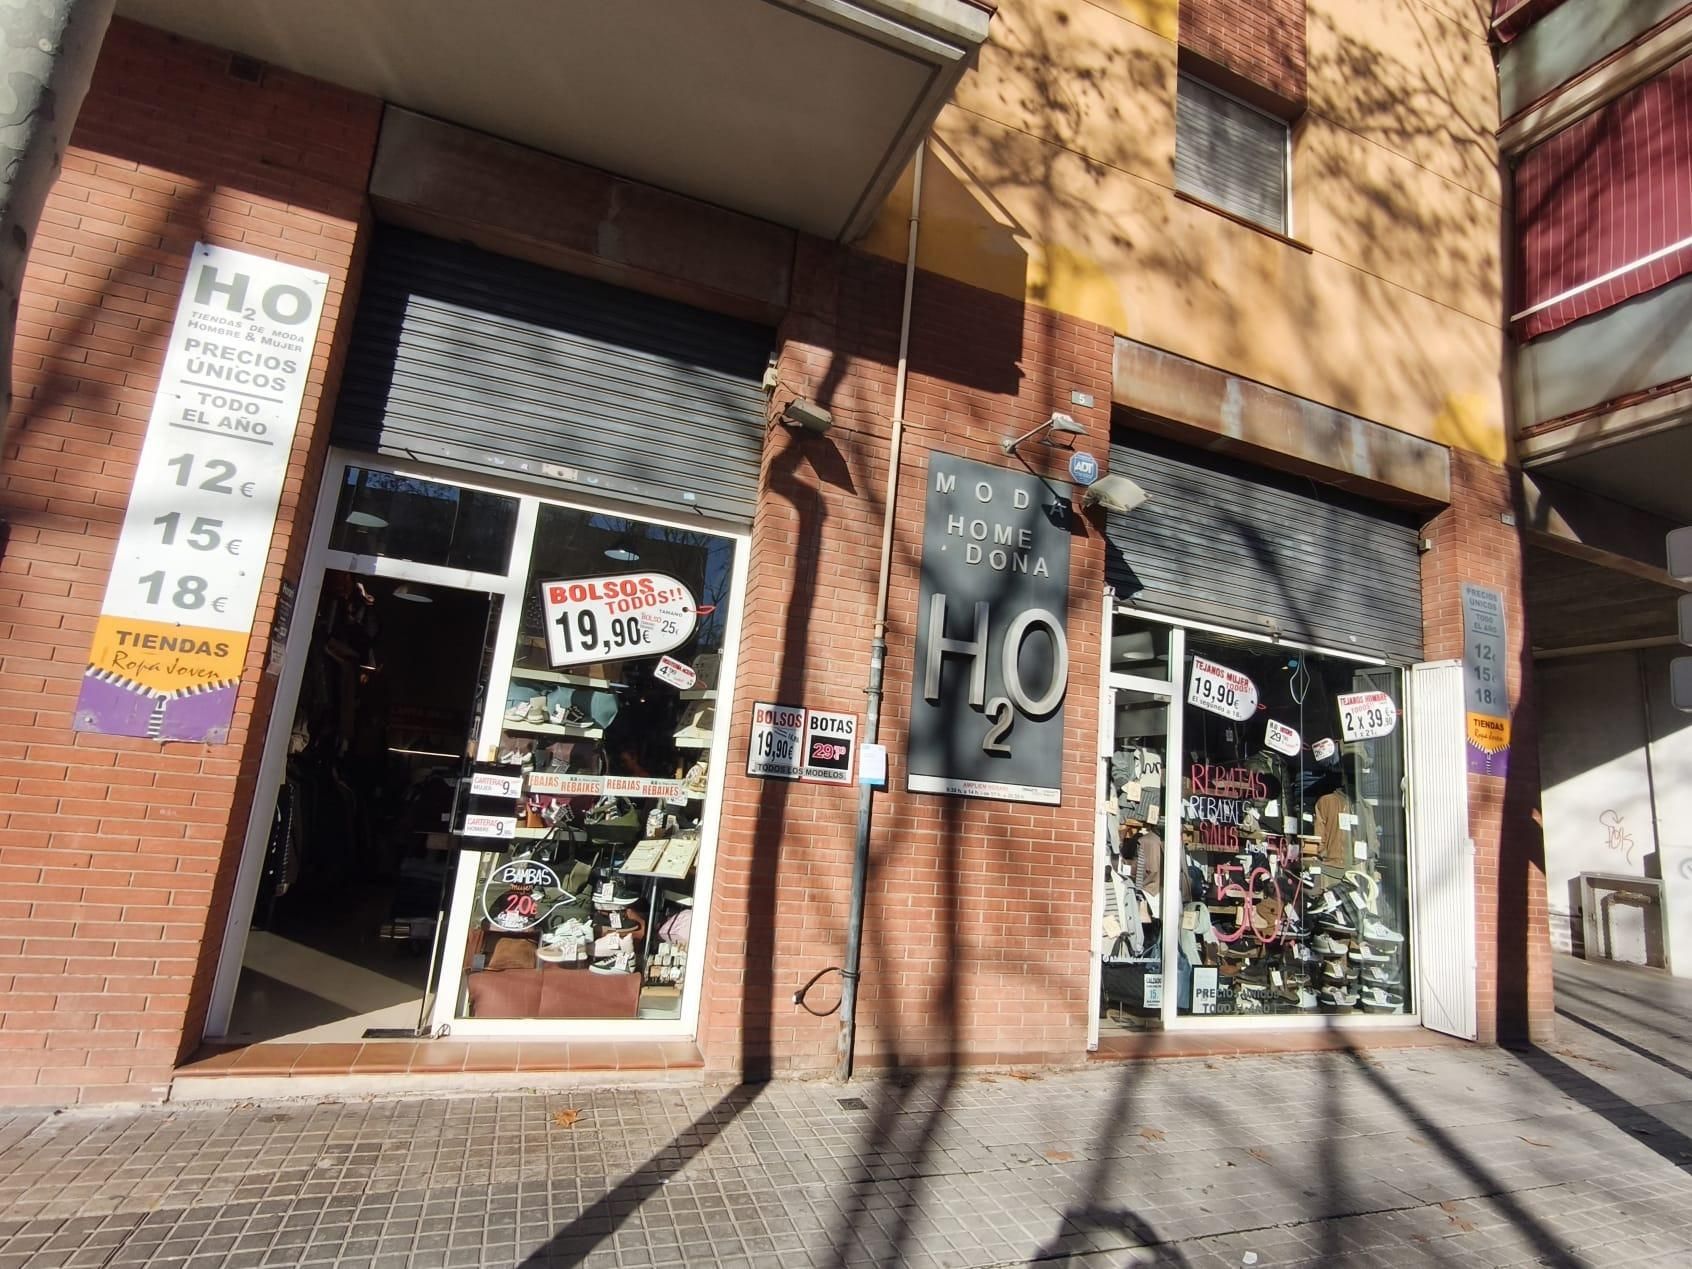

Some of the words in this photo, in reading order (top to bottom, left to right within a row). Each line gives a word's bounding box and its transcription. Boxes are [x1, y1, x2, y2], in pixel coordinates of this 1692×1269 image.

[194, 264, 313, 326] H2O
[191, 311, 242, 329] TIENDAS
[249, 325, 265, 334] DE
[272, 330, 305, 343] MODA
[245, 332, 256, 343] &
[184, 338, 297, 375] PRECIOS
[186, 356, 287, 392] ÚNICOS
[198, 392, 260, 415] TODO
[1078, 394, 1087, 405] 5
[181, 408, 210, 424] EL
[217, 417, 268, 437] AÑO
[1074, 461, 1093, 474] ADT
[948, 514, 1033, 550] HOME
[965, 543, 1049, 578] DONA
[549, 578, 655, 605] BOLSOS
[605, 588, 684, 615] TODOS!!
[1466, 587, 1498, 601] PRECIOS
[1475, 613, 1494, 624] TODO
[115, 630, 229, 658] TIENDAS
[111, 650, 162, 676] Ropa
[924, 593, 1069, 753] H2O
[1195, 660, 1225, 679] TEJANOS
[1226, 671, 1249, 688] MUJER
[756, 709, 802, 728] BOLSOS
[810, 716, 853, 734] BOTAS
[1345, 712, 1354, 731] 2
[1367, 708, 1383, 728] 39
[1473, 718, 1505, 731] TIENDAS
[757, 763, 786, 773] TODOS
[787, 766, 803, 775] LOS
[805, 768, 844, 779] MODELOS
[502, 780, 510, 795] 9
[560, 781, 600, 793] REBAIXES
[607, 778, 640, 791] REBAJAS
[642, 784, 680, 797] REBAIXES
[496, 821, 504, 836] 9
[502, 867, 552, 885] BAMBAS
